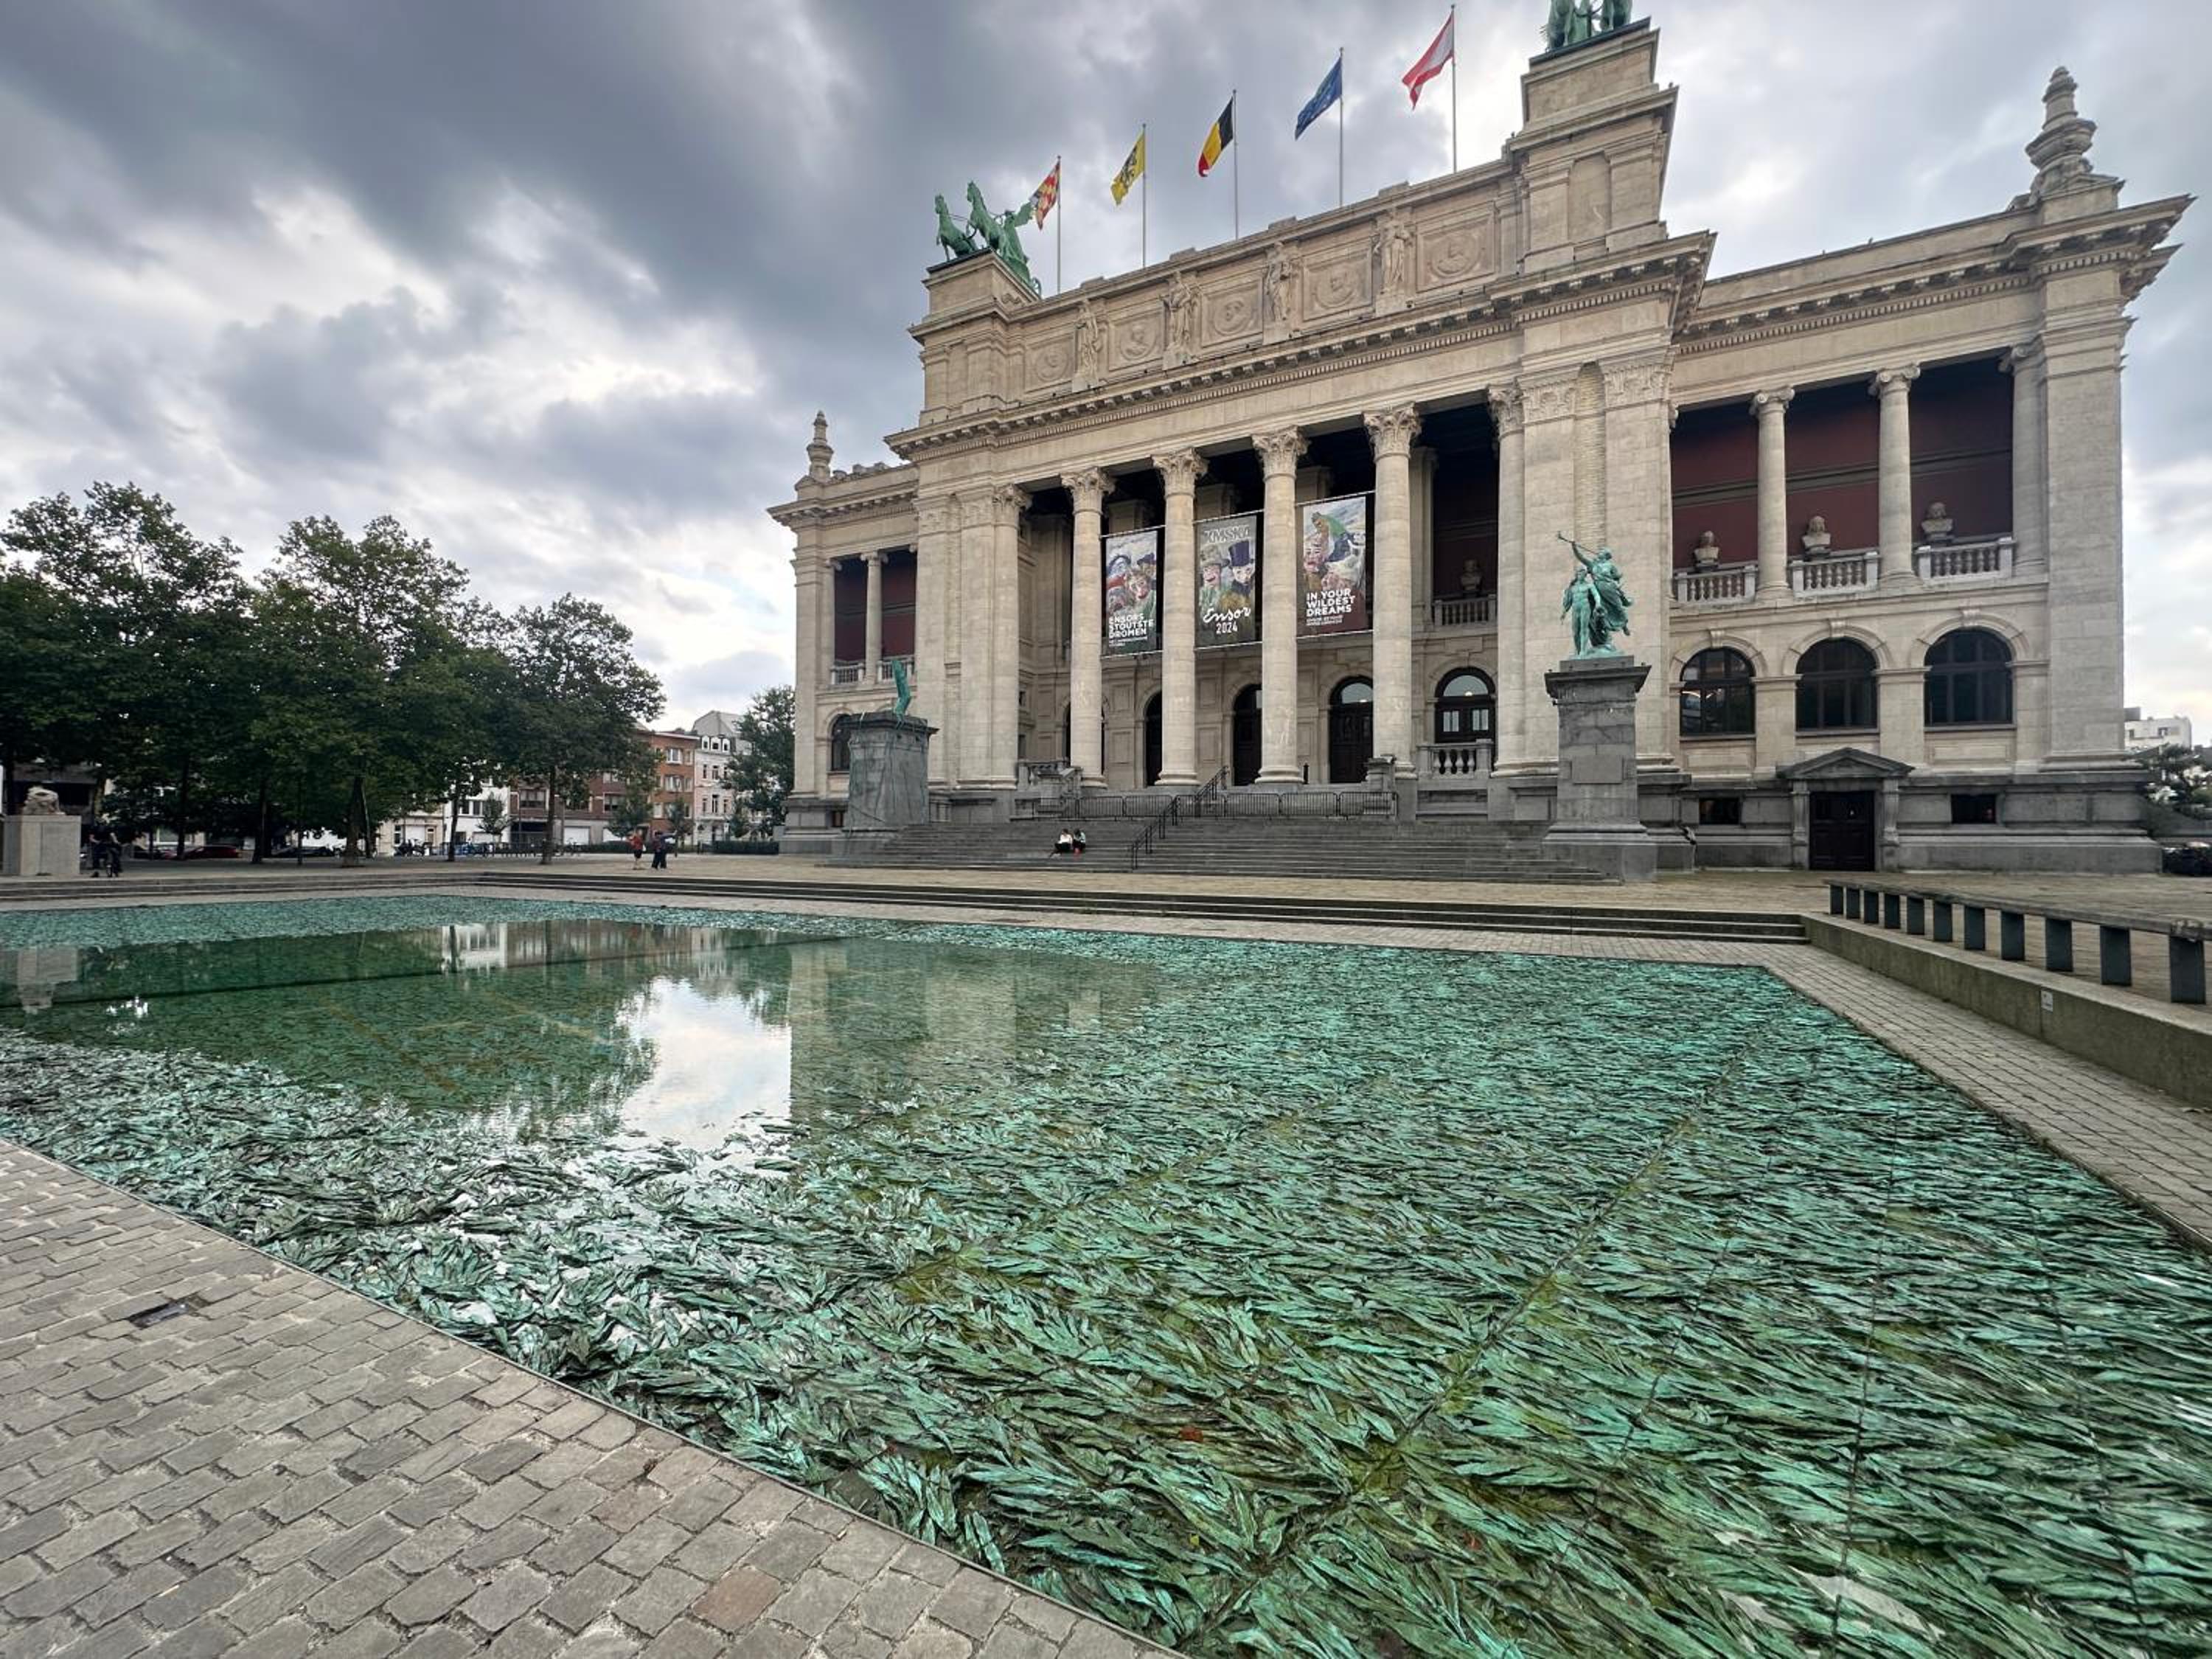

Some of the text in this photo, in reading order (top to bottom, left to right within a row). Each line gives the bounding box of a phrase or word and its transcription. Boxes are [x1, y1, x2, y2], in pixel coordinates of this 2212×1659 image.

[1306, 588, 1352, 601] IN YOUR
[1306, 596, 1355, 608] WILDEST
[1203, 607, 1251, 623] Ensor
[1306, 605, 1352, 616] DREAMS
[1109, 619, 1154, 632] STOUTSTE
[1216, 621, 1238, 634] 2024
[1109, 628, 1147, 639] DROMEN
